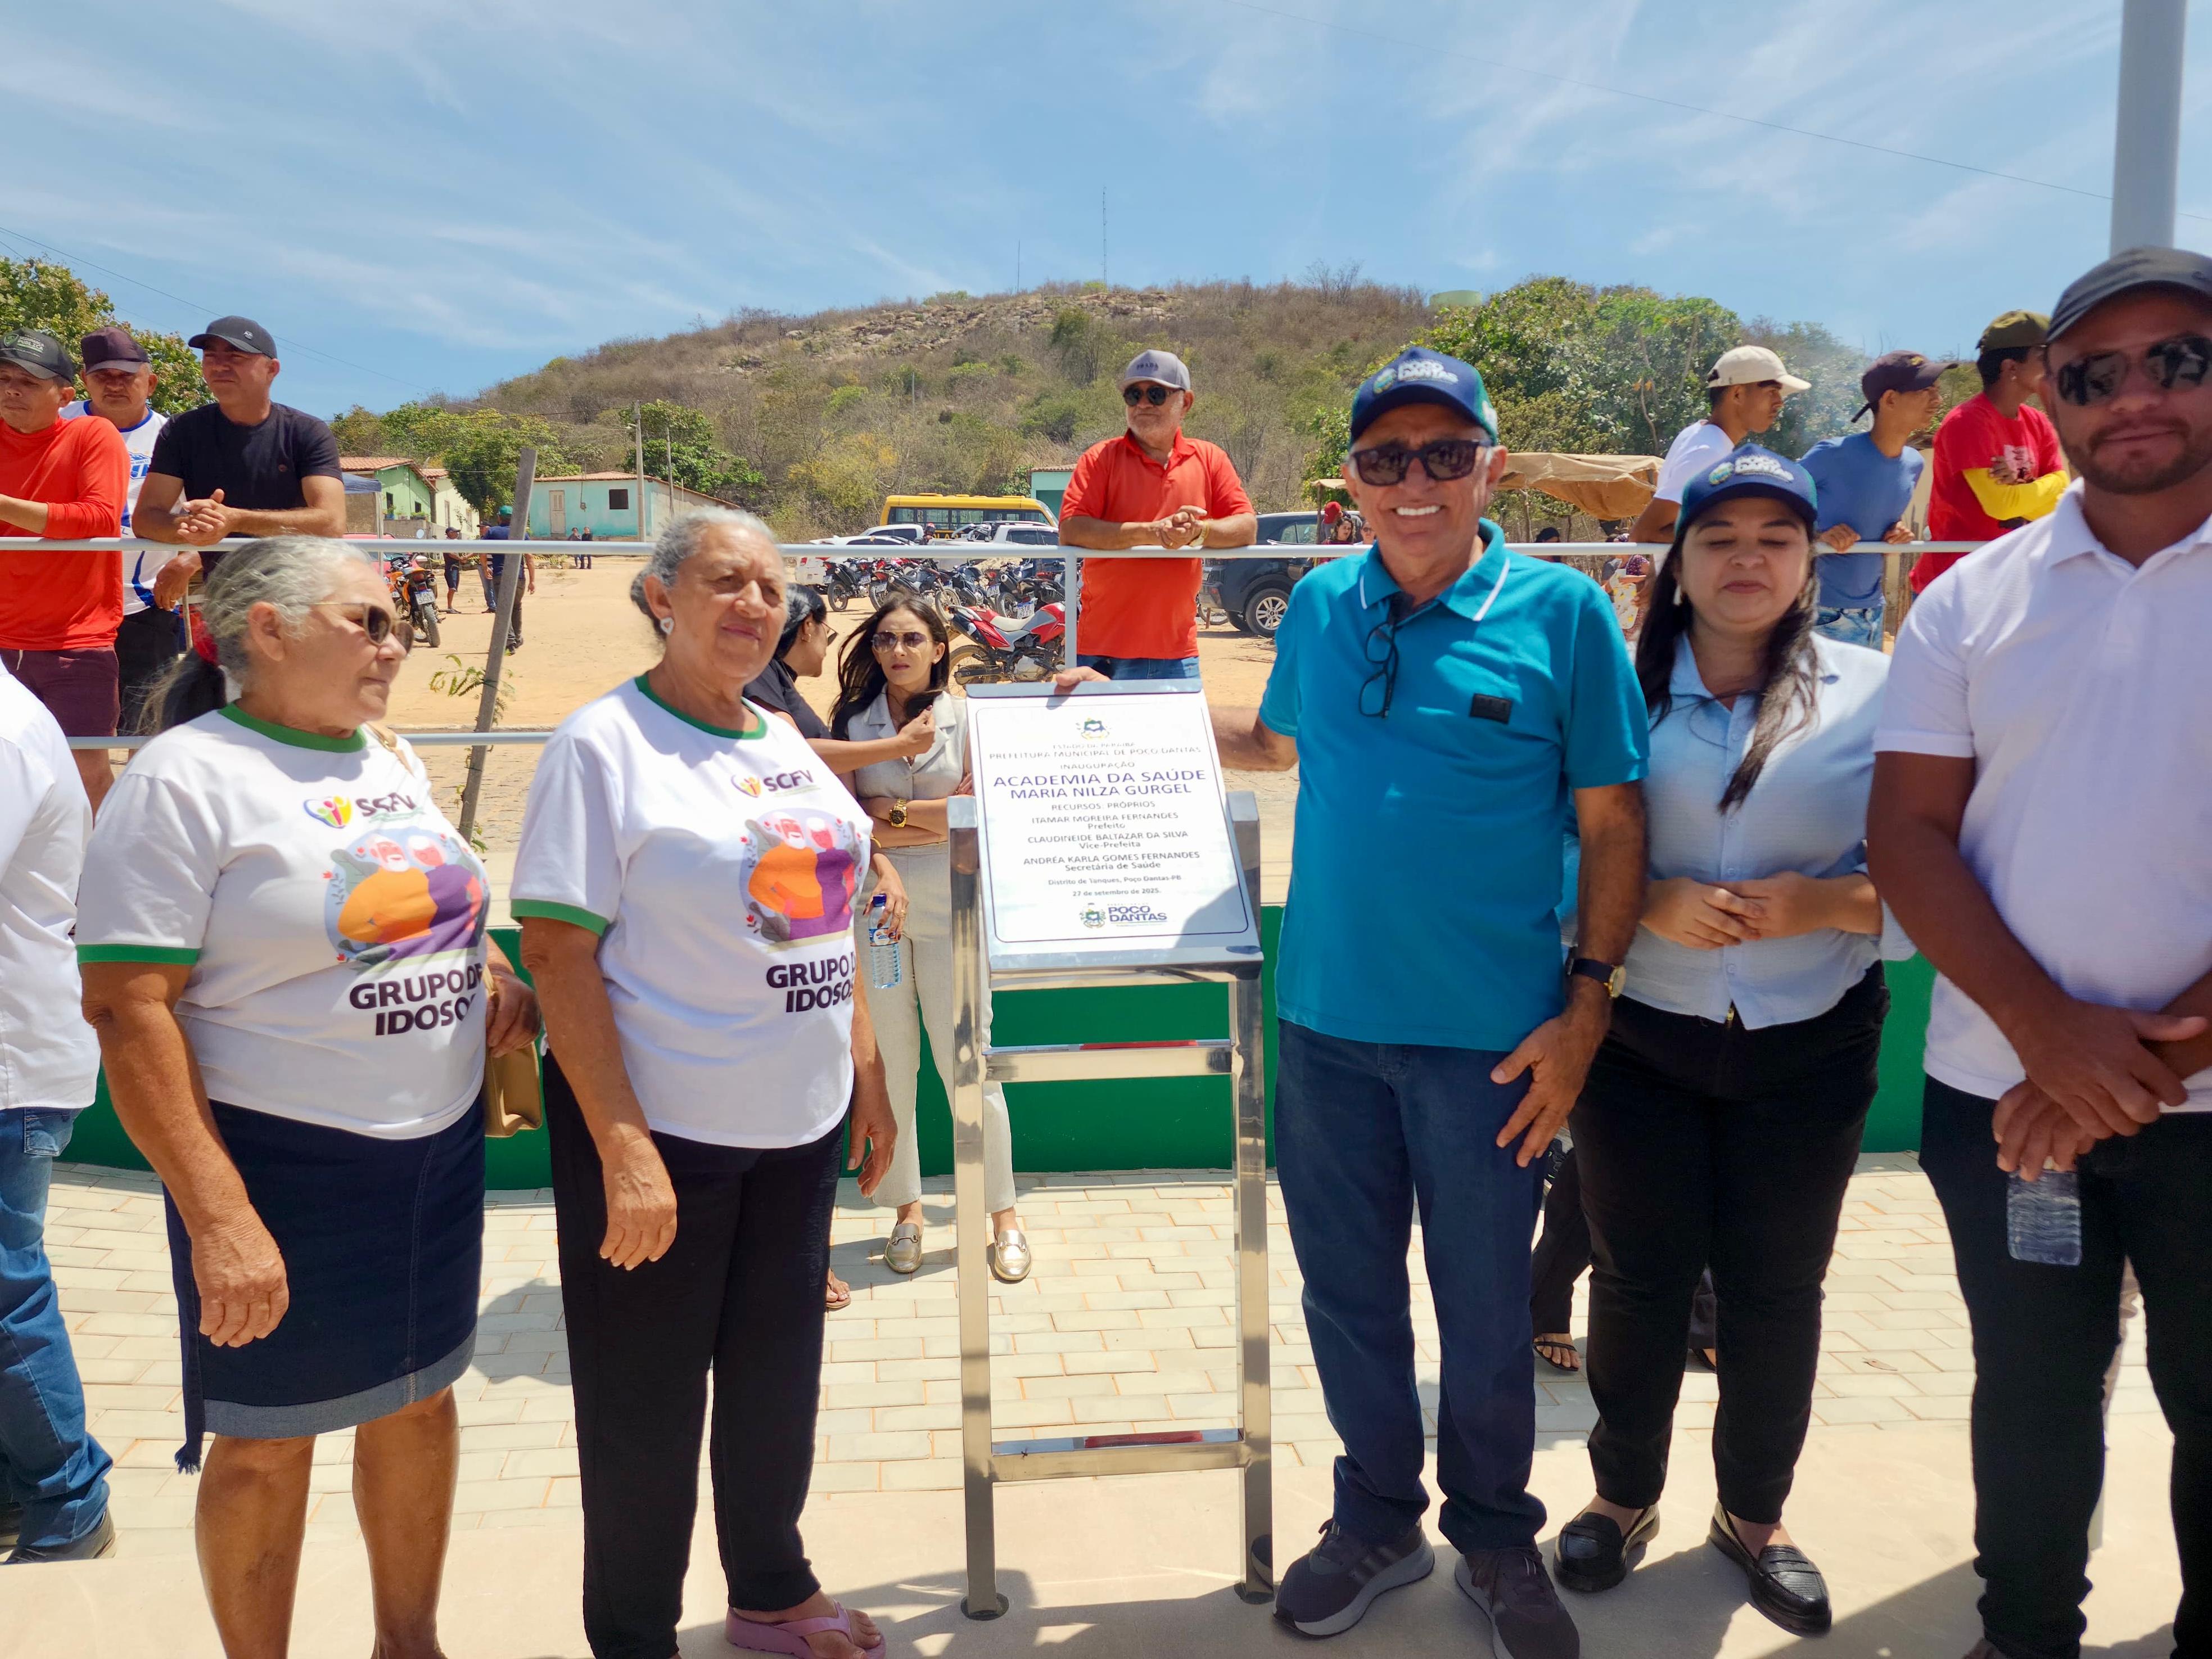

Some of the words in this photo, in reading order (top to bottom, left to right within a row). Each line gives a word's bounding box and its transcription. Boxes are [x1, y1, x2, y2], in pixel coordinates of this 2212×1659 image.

[764, 769, 813, 792] SCFV
[994, 774, 1100, 786] ACADEMIA
[1107, 772, 1135, 783] DA
[1141, 768, 1206, 781] SAÚDE
[1011, 788, 1068, 799] MARIA
[1073, 786, 1120, 797] NILZA
[1125, 784, 1191, 795] GURGEL
[355, 792, 417, 817] SCFV
[1028, 834, 1093, 843] CLAUDINEIDE
[1096, 832, 1144, 840] BALTAZAR
[1079, 840, 1141, 849] Vice-Prefeita
[1023, 856, 1066, 865] ANDRÉA
[1103, 853, 1139, 862] GOMES
[1141, 851, 1200, 860] FERNANDES
[1065, 863, 1114, 871] Secretária
[1109, 912, 1167, 921] DANTAS
[766, 955, 849, 988] GRUPO
[349, 969, 464, 1010] GRUPO
